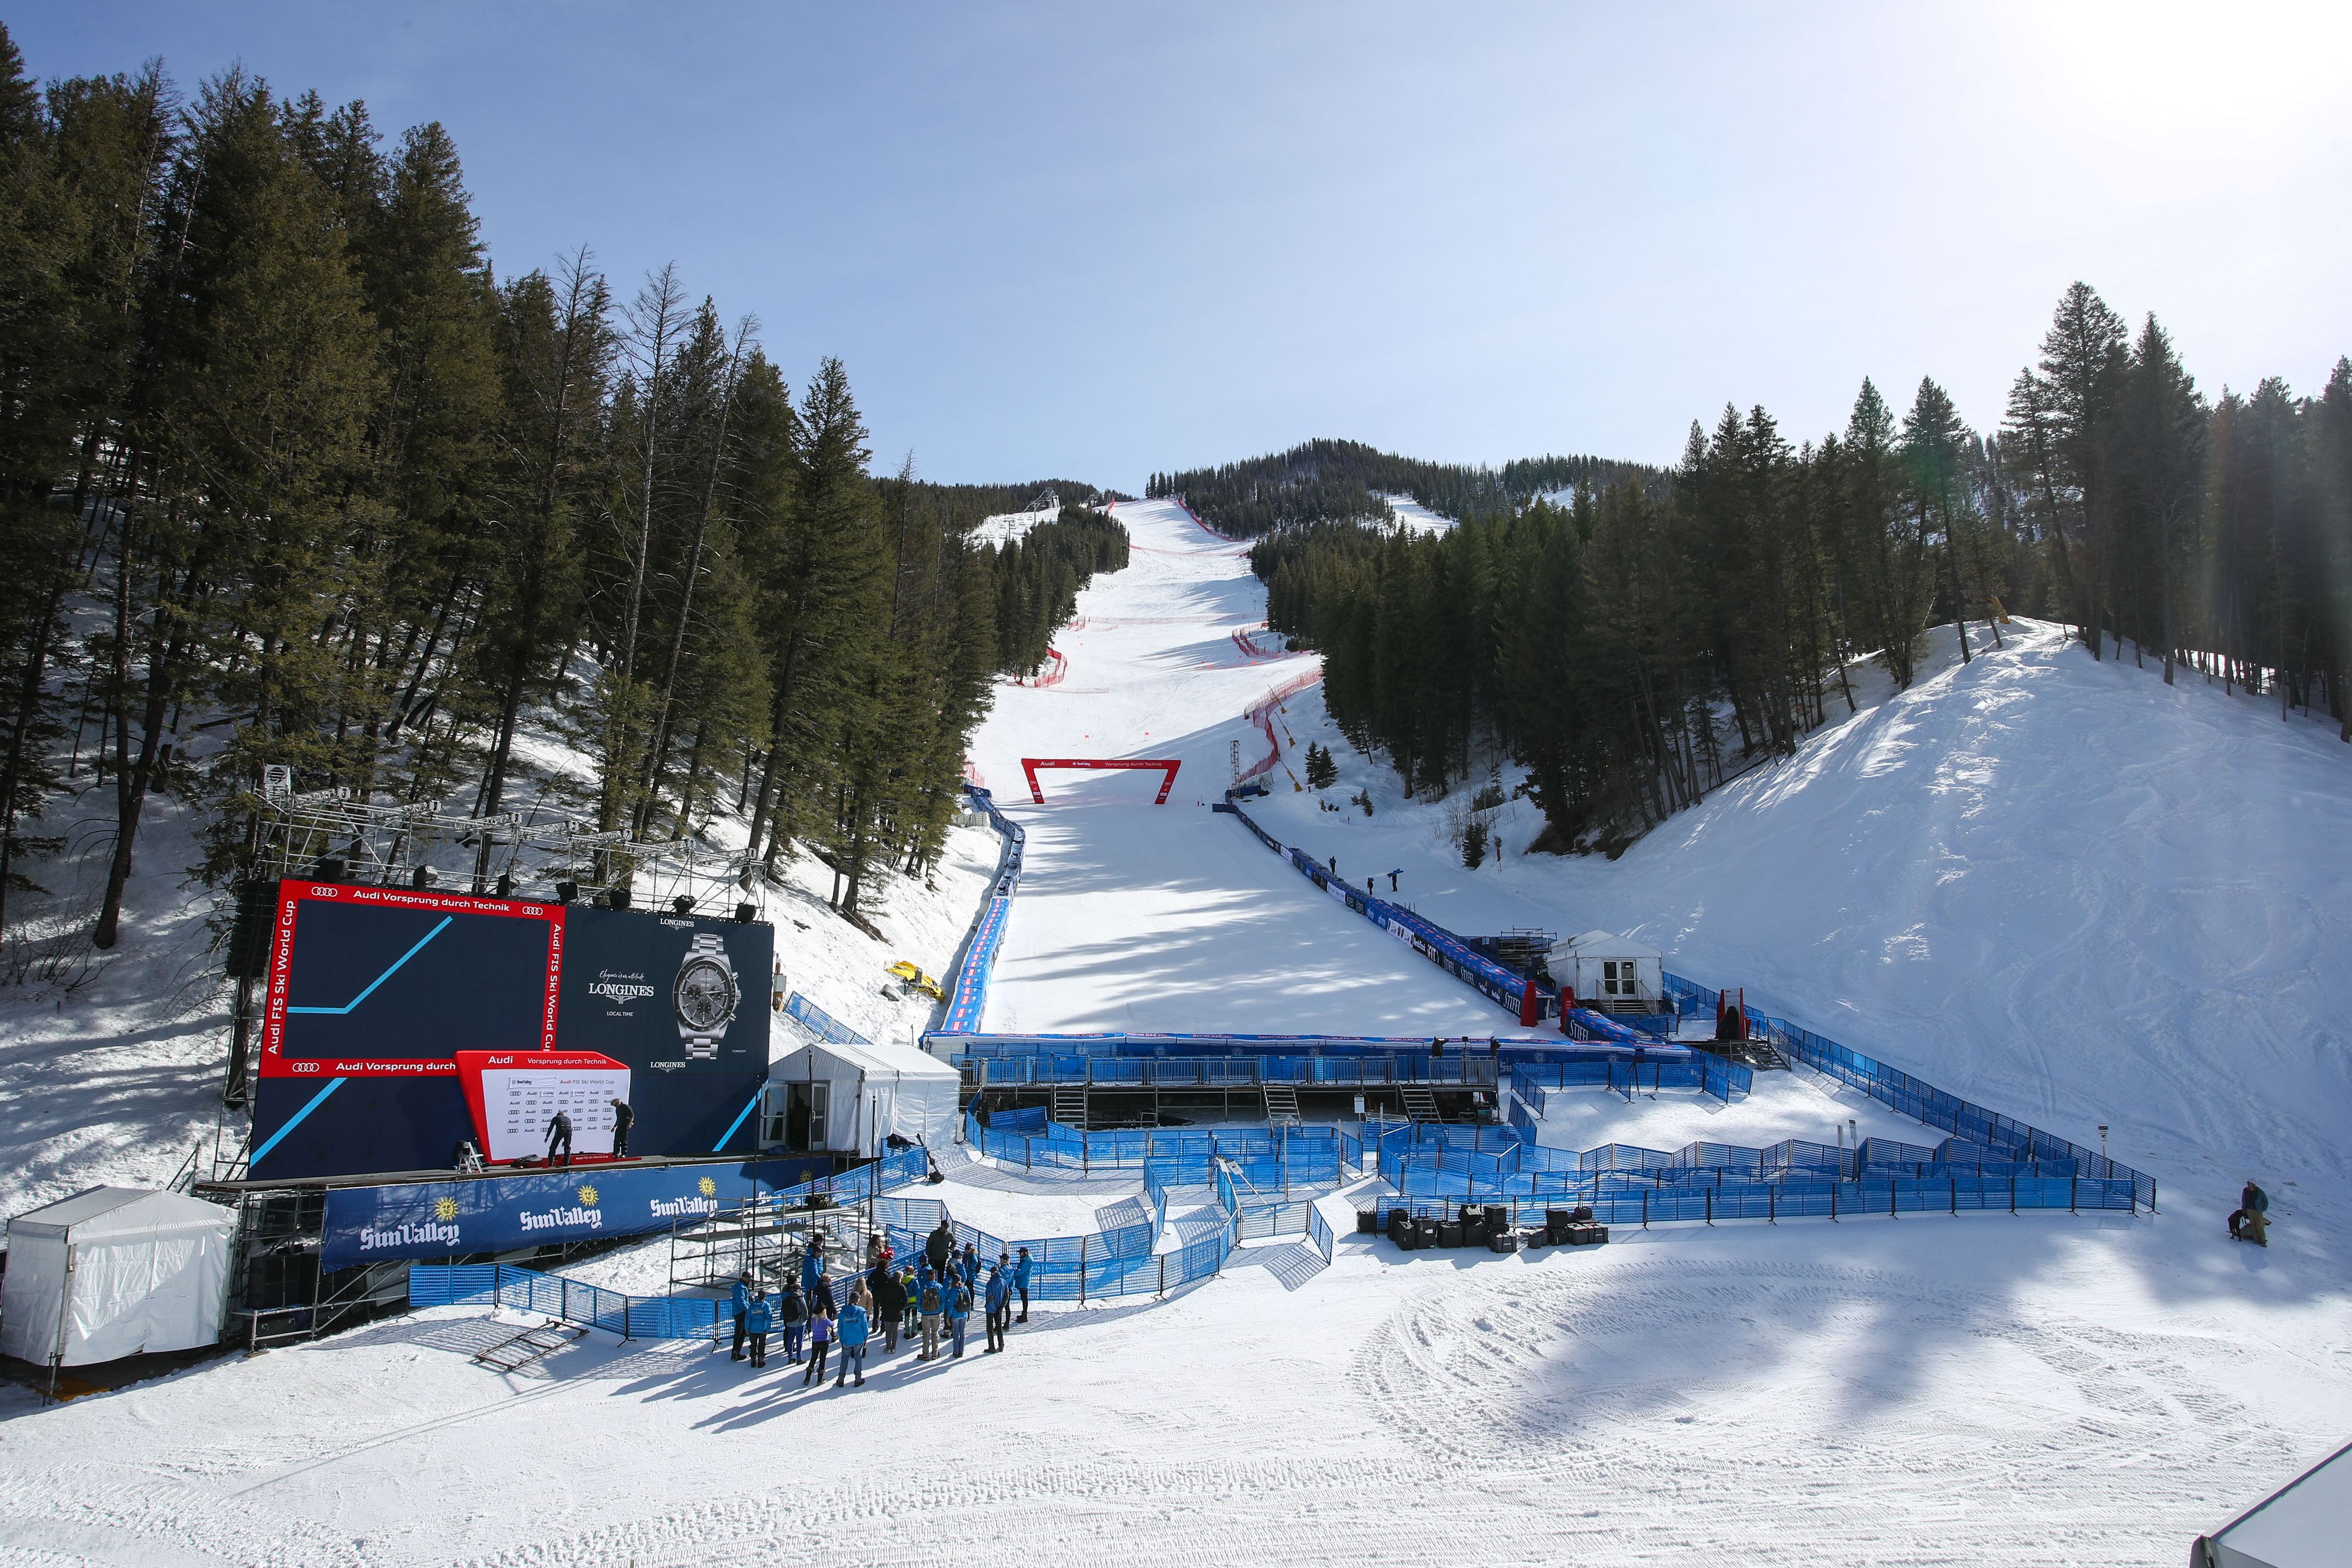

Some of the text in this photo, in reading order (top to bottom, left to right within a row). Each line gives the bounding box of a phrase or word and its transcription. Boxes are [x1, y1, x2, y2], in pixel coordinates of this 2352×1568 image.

[353, 890, 510, 911] Audi Vorsprung durch Technik
[660, 918, 694, 927] LONGINES
[268, 900, 296, 1055] Audi FIS Ski World Cup
[1461, 966, 1475, 986] STIFEL
[543, 924, 562, 1051] Audi FIS Ski World Cu
[589, 983, 654, 997] LONGINES
[1504, 992, 1521, 1015] STIFEL
[335, 1062, 363, 1071] Audi
[366, 1062, 424, 1072] Vorsprung
[488, 1055, 513, 1064] Audi
